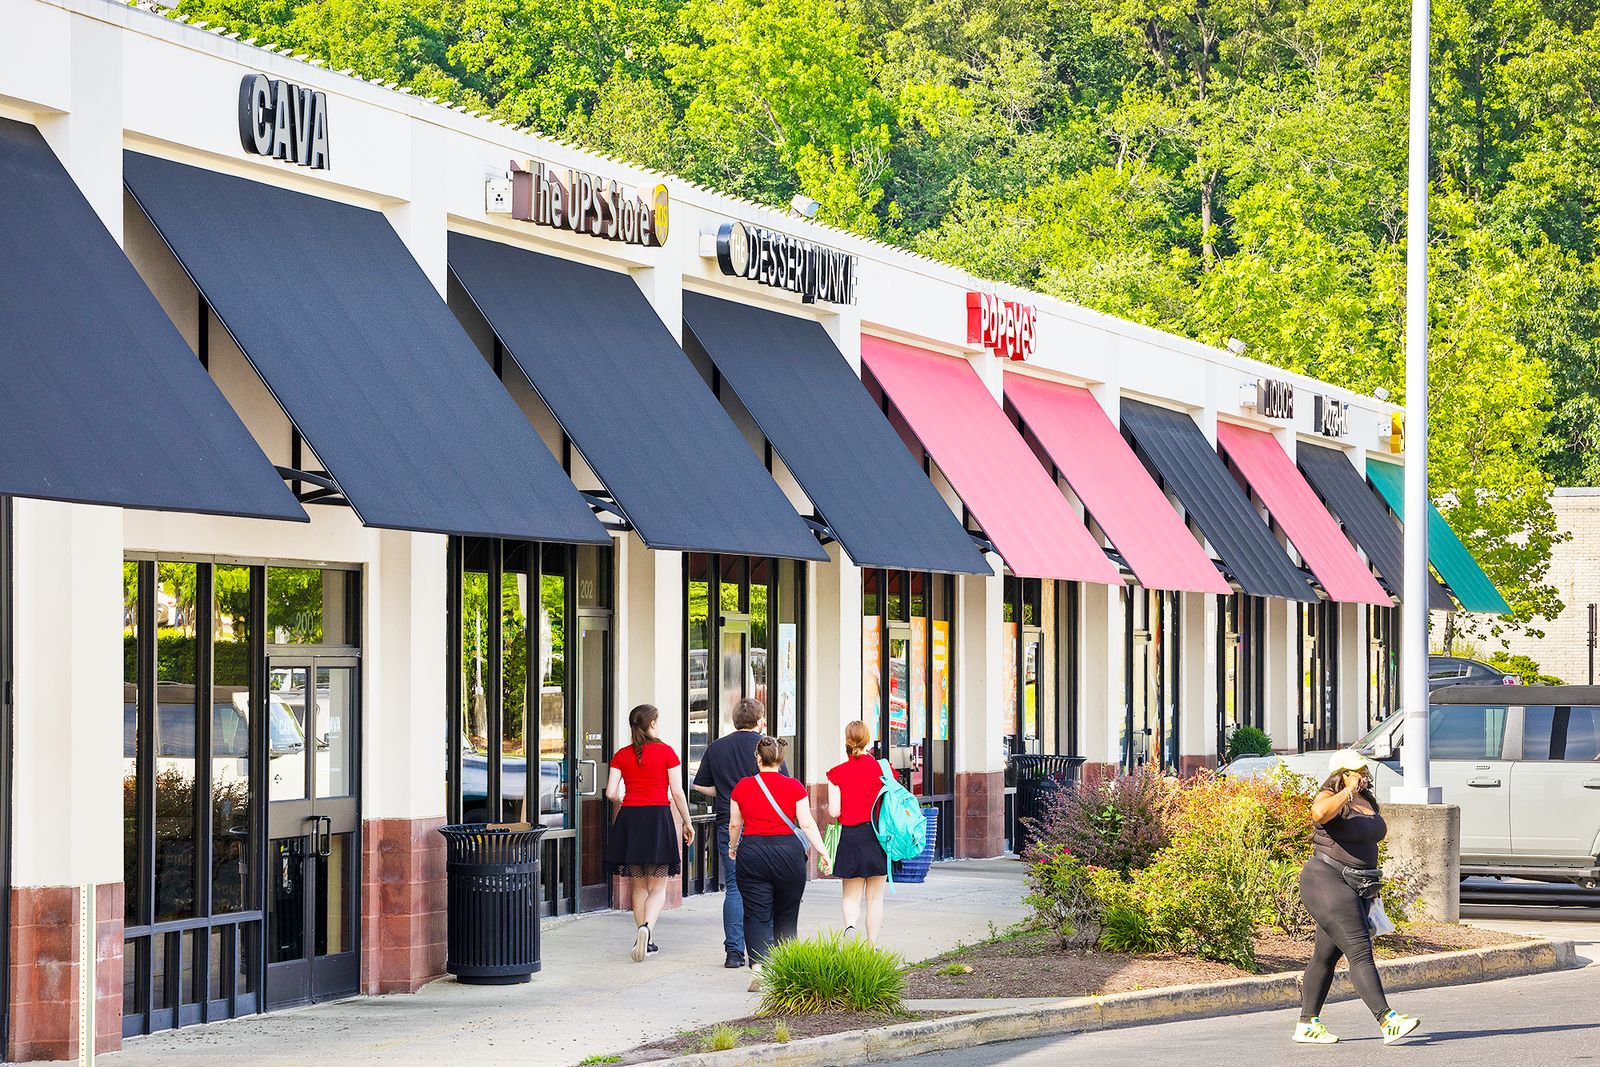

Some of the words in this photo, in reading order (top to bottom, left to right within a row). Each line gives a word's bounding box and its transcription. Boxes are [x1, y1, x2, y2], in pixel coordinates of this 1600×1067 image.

[241, 74, 330, 170] CAVA
[523, 160, 562, 228] The
[567, 169, 603, 236] UPS
[607, 179, 651, 246] Store
[748, 226, 812, 295] DESSERT
[811, 245, 859, 306] JUNKIE
[295, 612, 314, 634] 200
[580, 579, 593, 599] 202
